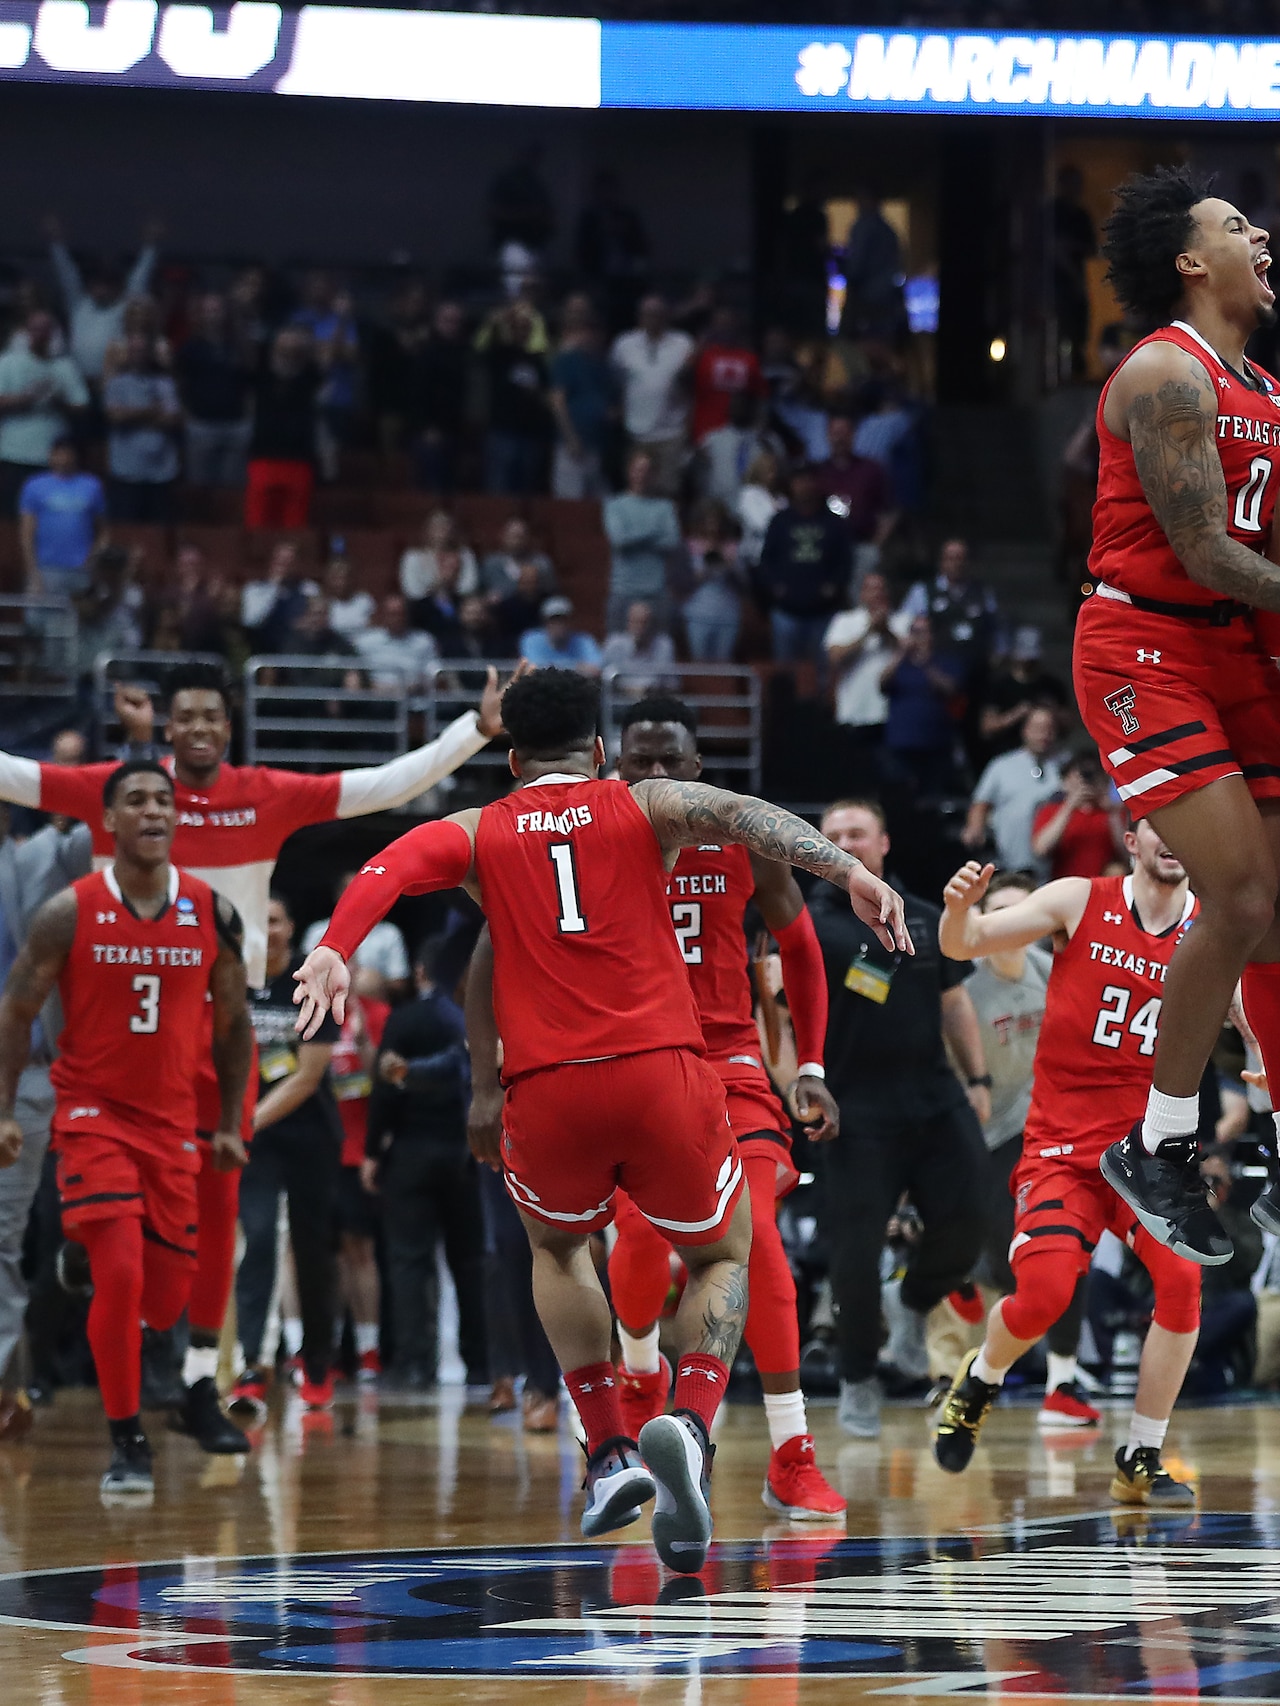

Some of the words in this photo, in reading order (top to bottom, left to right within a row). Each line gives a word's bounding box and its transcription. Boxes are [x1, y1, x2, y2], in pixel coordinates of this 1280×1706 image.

[1217, 415, 1271, 446] TEXAS
[1234, 456, 1272, 532] 0
[516, 804, 593, 836] FRANCIS
[549, 841, 588, 934] 1
[675, 874, 727, 895] TECH
[92, 944, 153, 966] TEXAS
[156, 947, 203, 967] TECH
[1089, 941, 1146, 976] TEXAS
[129, 973, 161, 1034] 3
[1092, 985, 1163, 1056] 24
